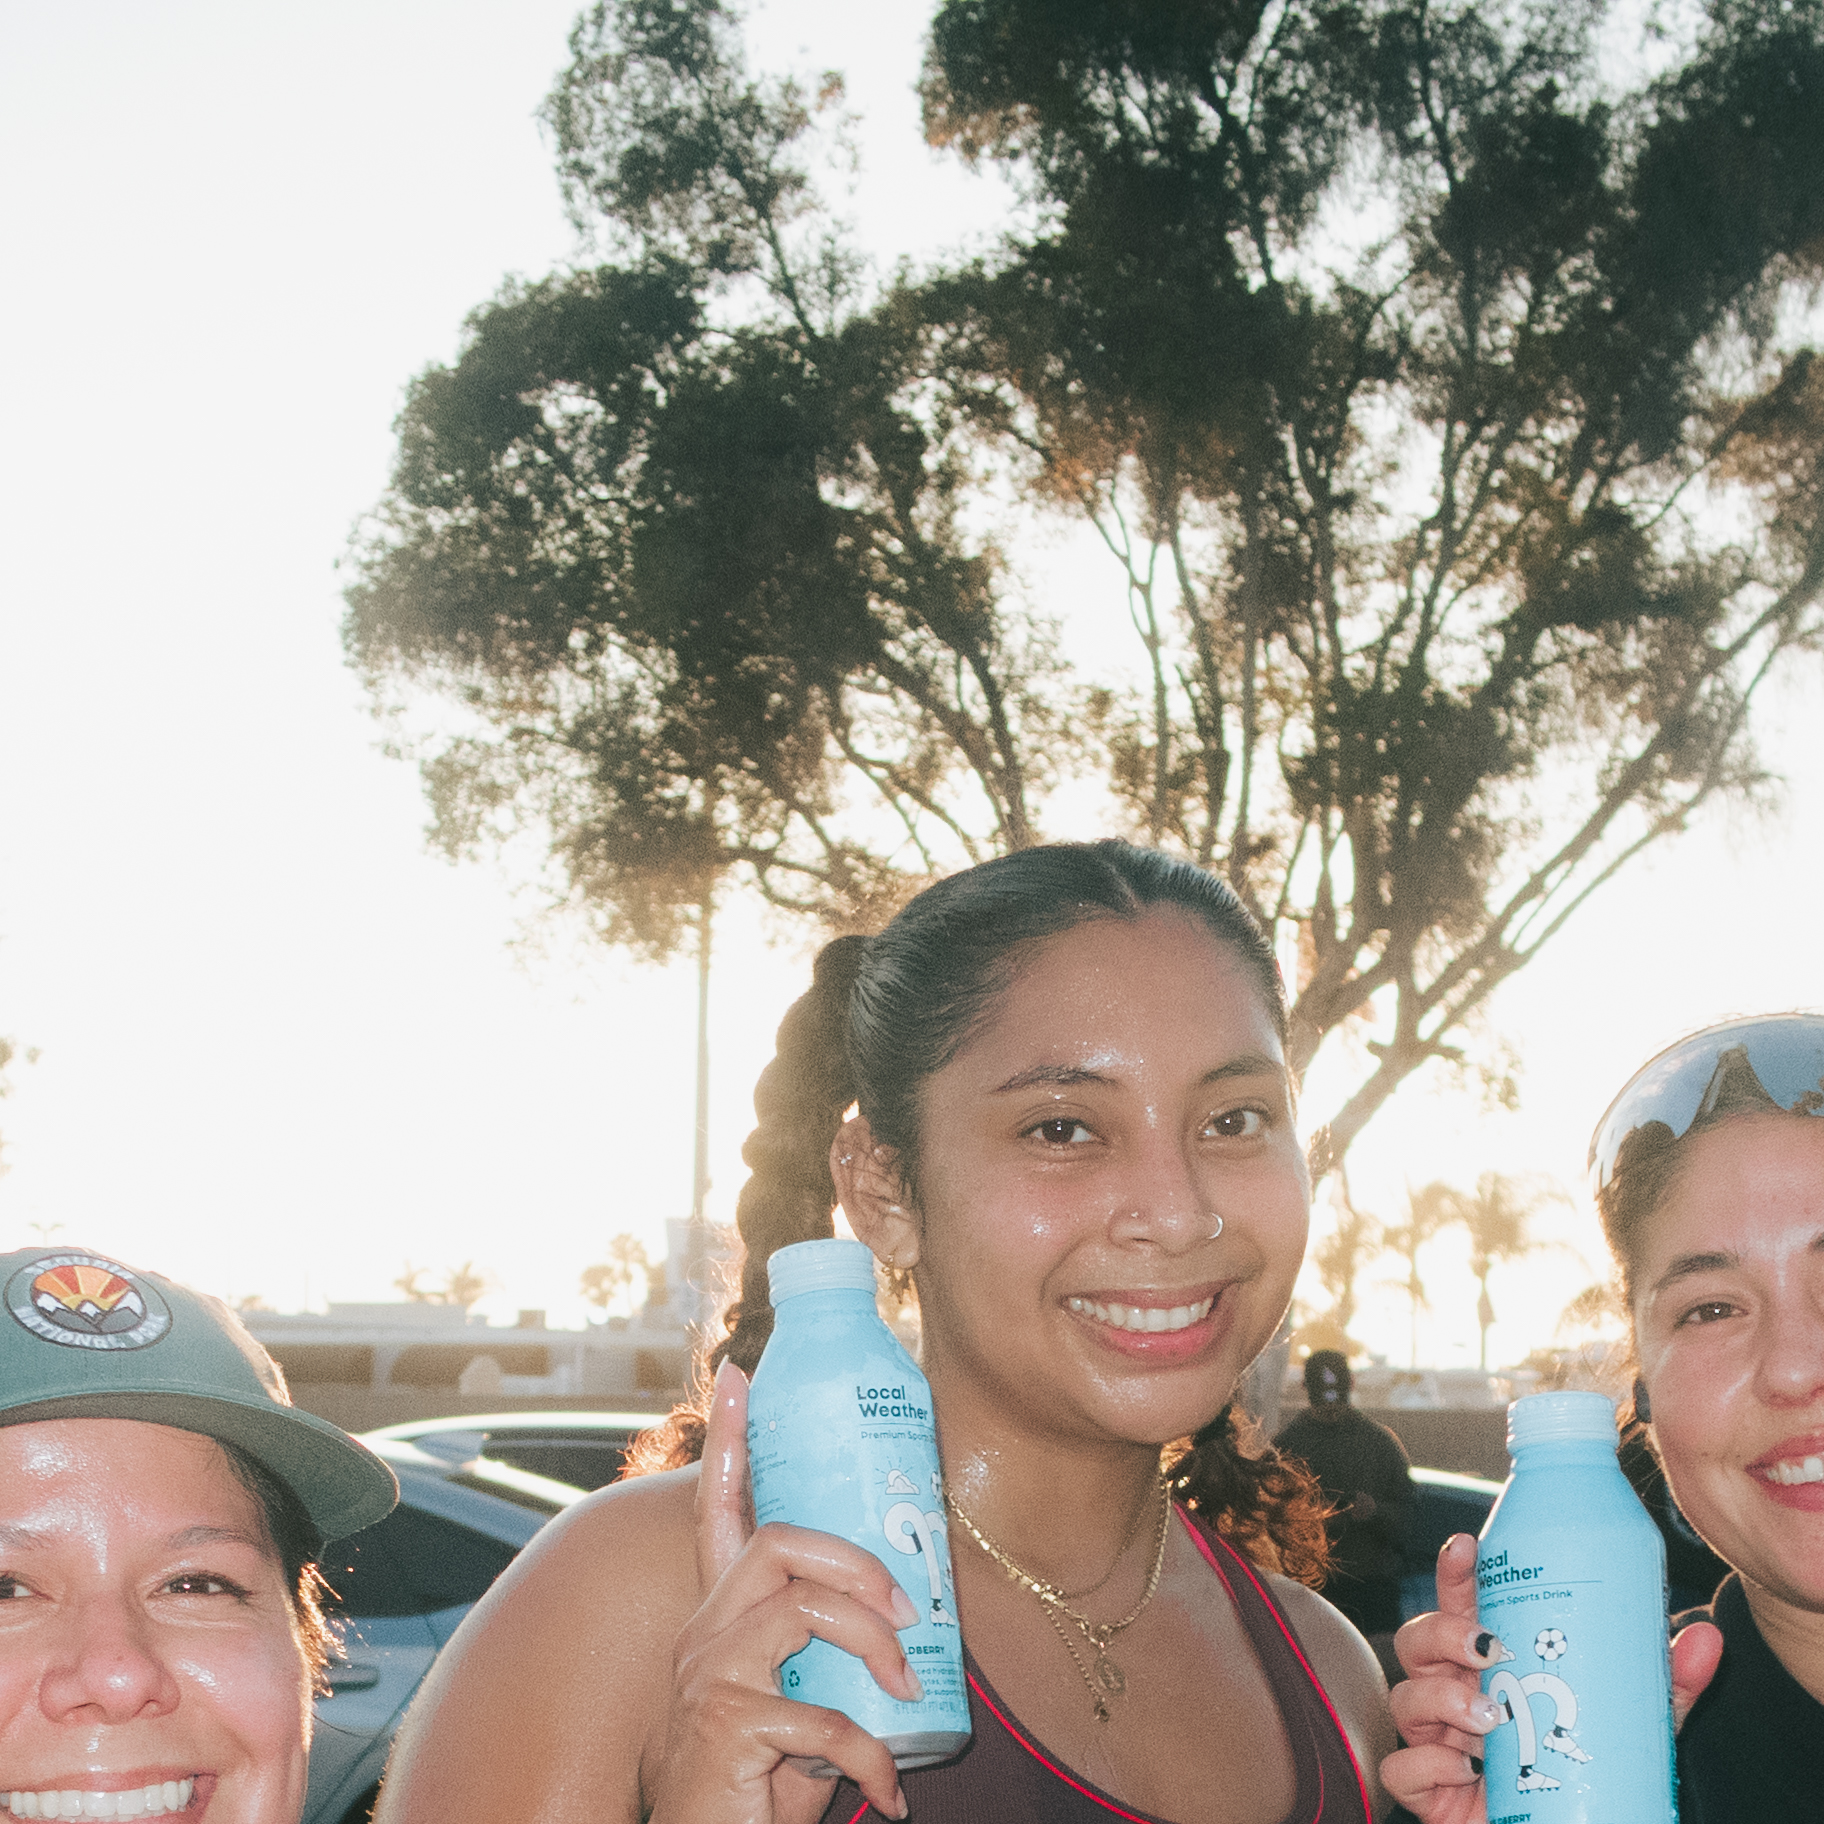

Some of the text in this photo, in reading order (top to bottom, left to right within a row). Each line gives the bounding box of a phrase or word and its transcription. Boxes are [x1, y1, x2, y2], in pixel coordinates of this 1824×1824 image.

[856, 1384, 906, 1400] Local
[858, 1402, 928, 1420] Weather
[861, 1430, 906, 1439] Premium
[1506, 1593, 1540, 1605] Sports
[1542, 1589, 1573, 1600] Drink
